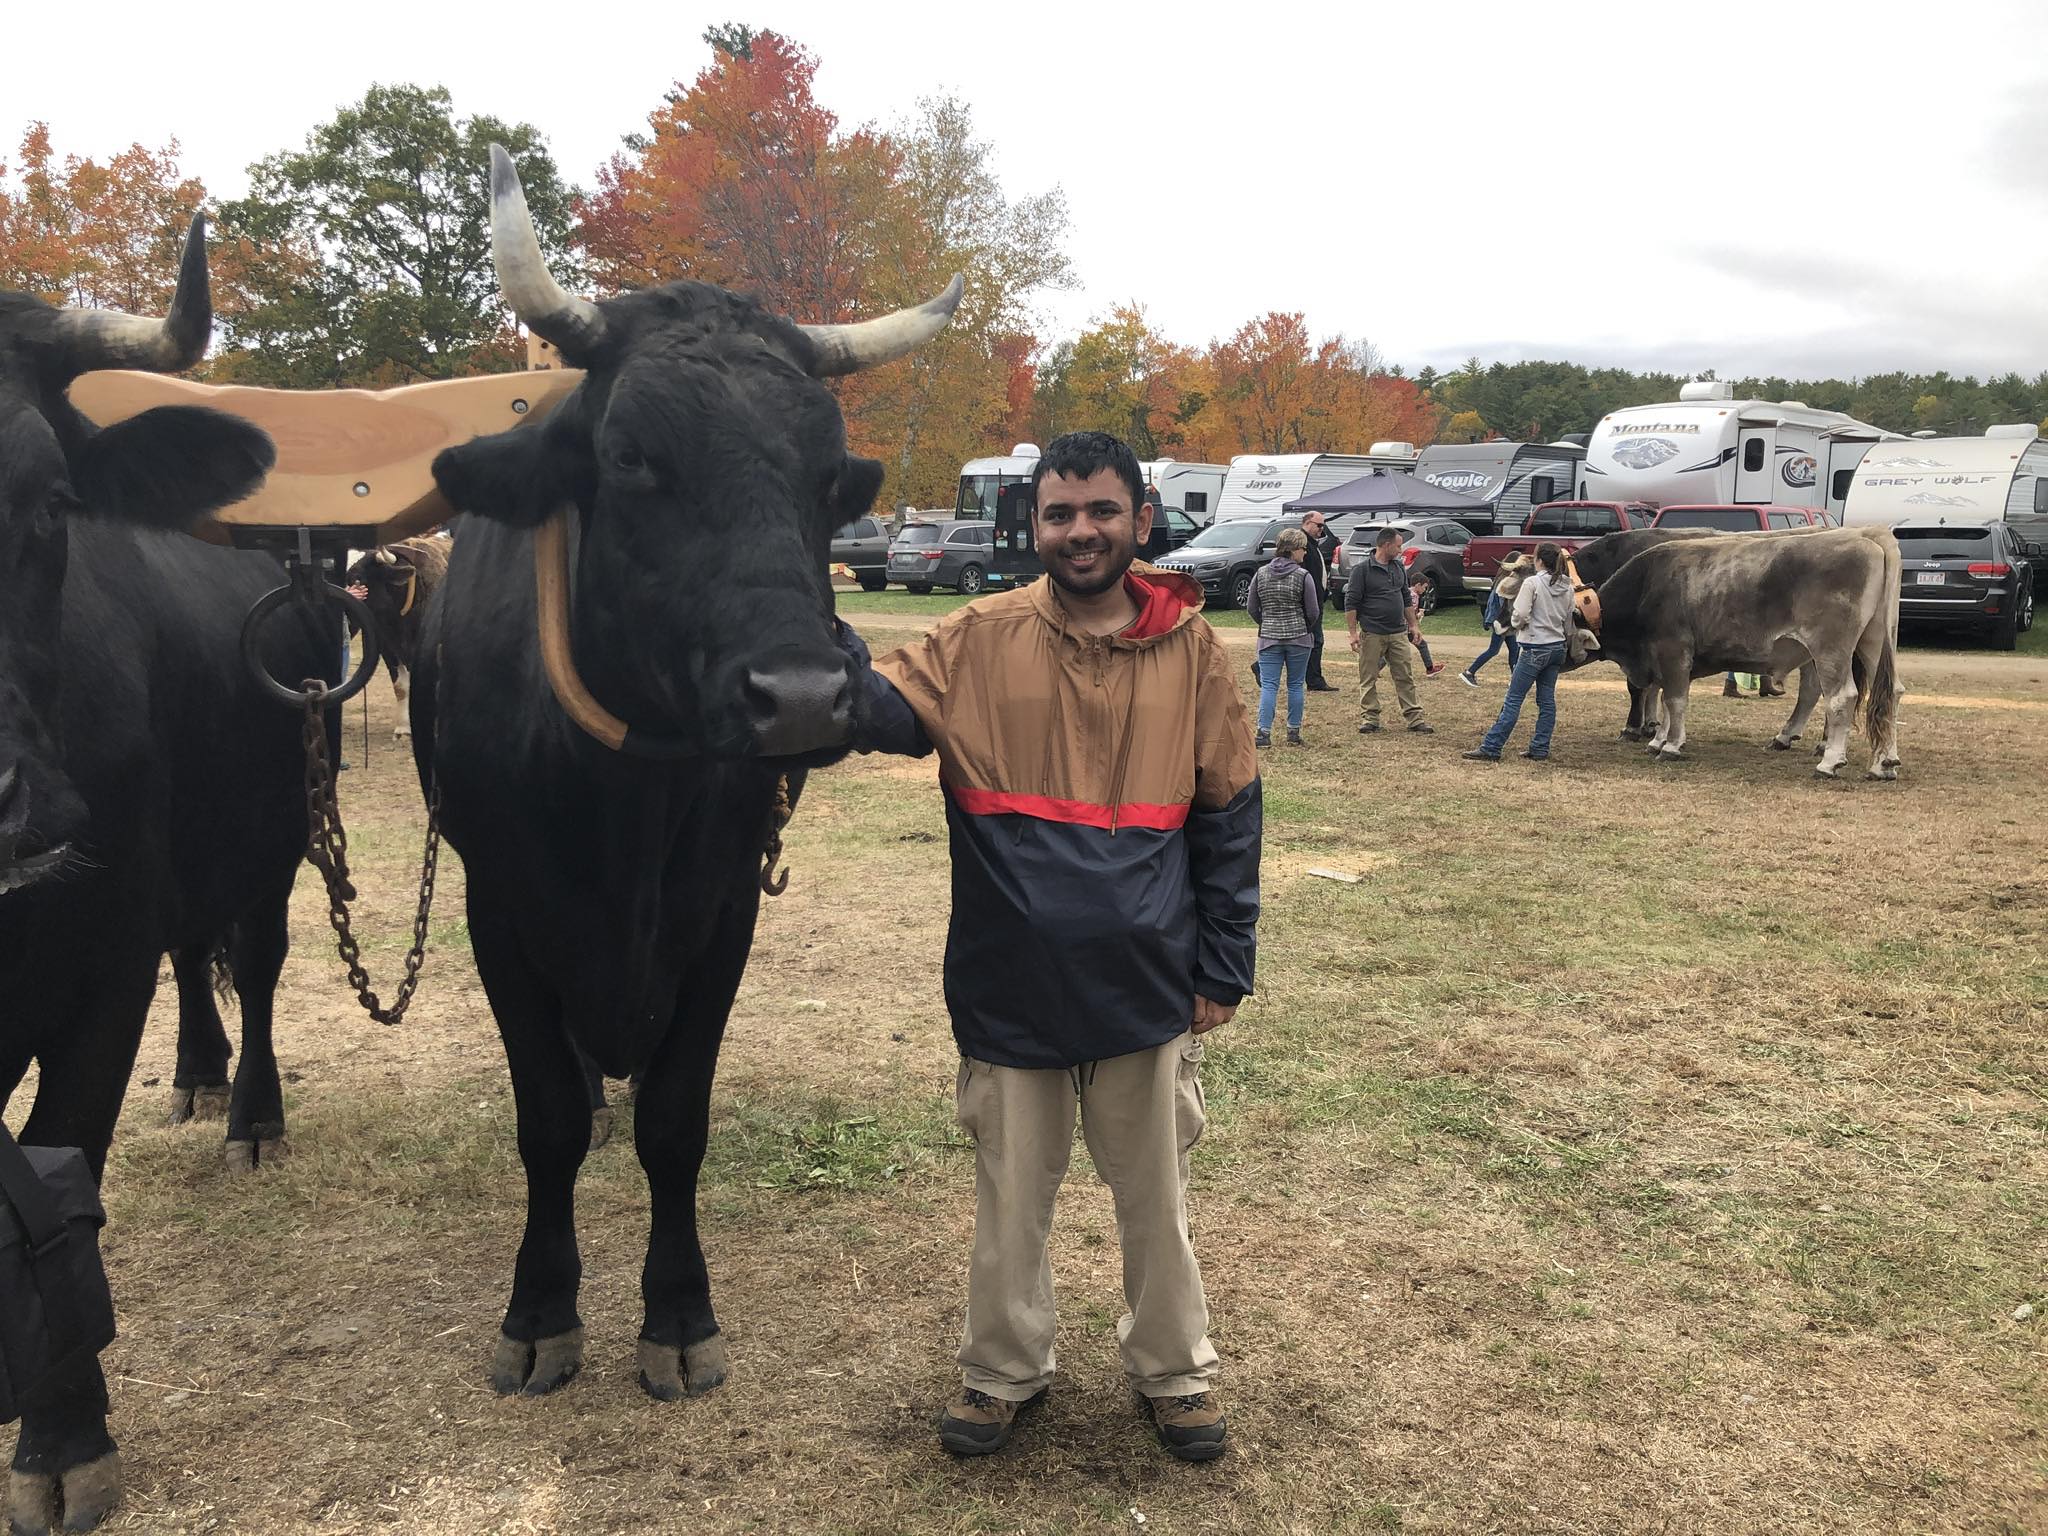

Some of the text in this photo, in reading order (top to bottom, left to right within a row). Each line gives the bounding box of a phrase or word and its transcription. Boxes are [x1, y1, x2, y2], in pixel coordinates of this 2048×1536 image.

[1608, 422, 1700, 437] Montana
[1245, 479, 1282, 490] Jayco
[1424, 473, 1493, 488] Prowler
[1864, 478, 1924, 487] GREY
[1923, 560, 1941, 569] Jeep
